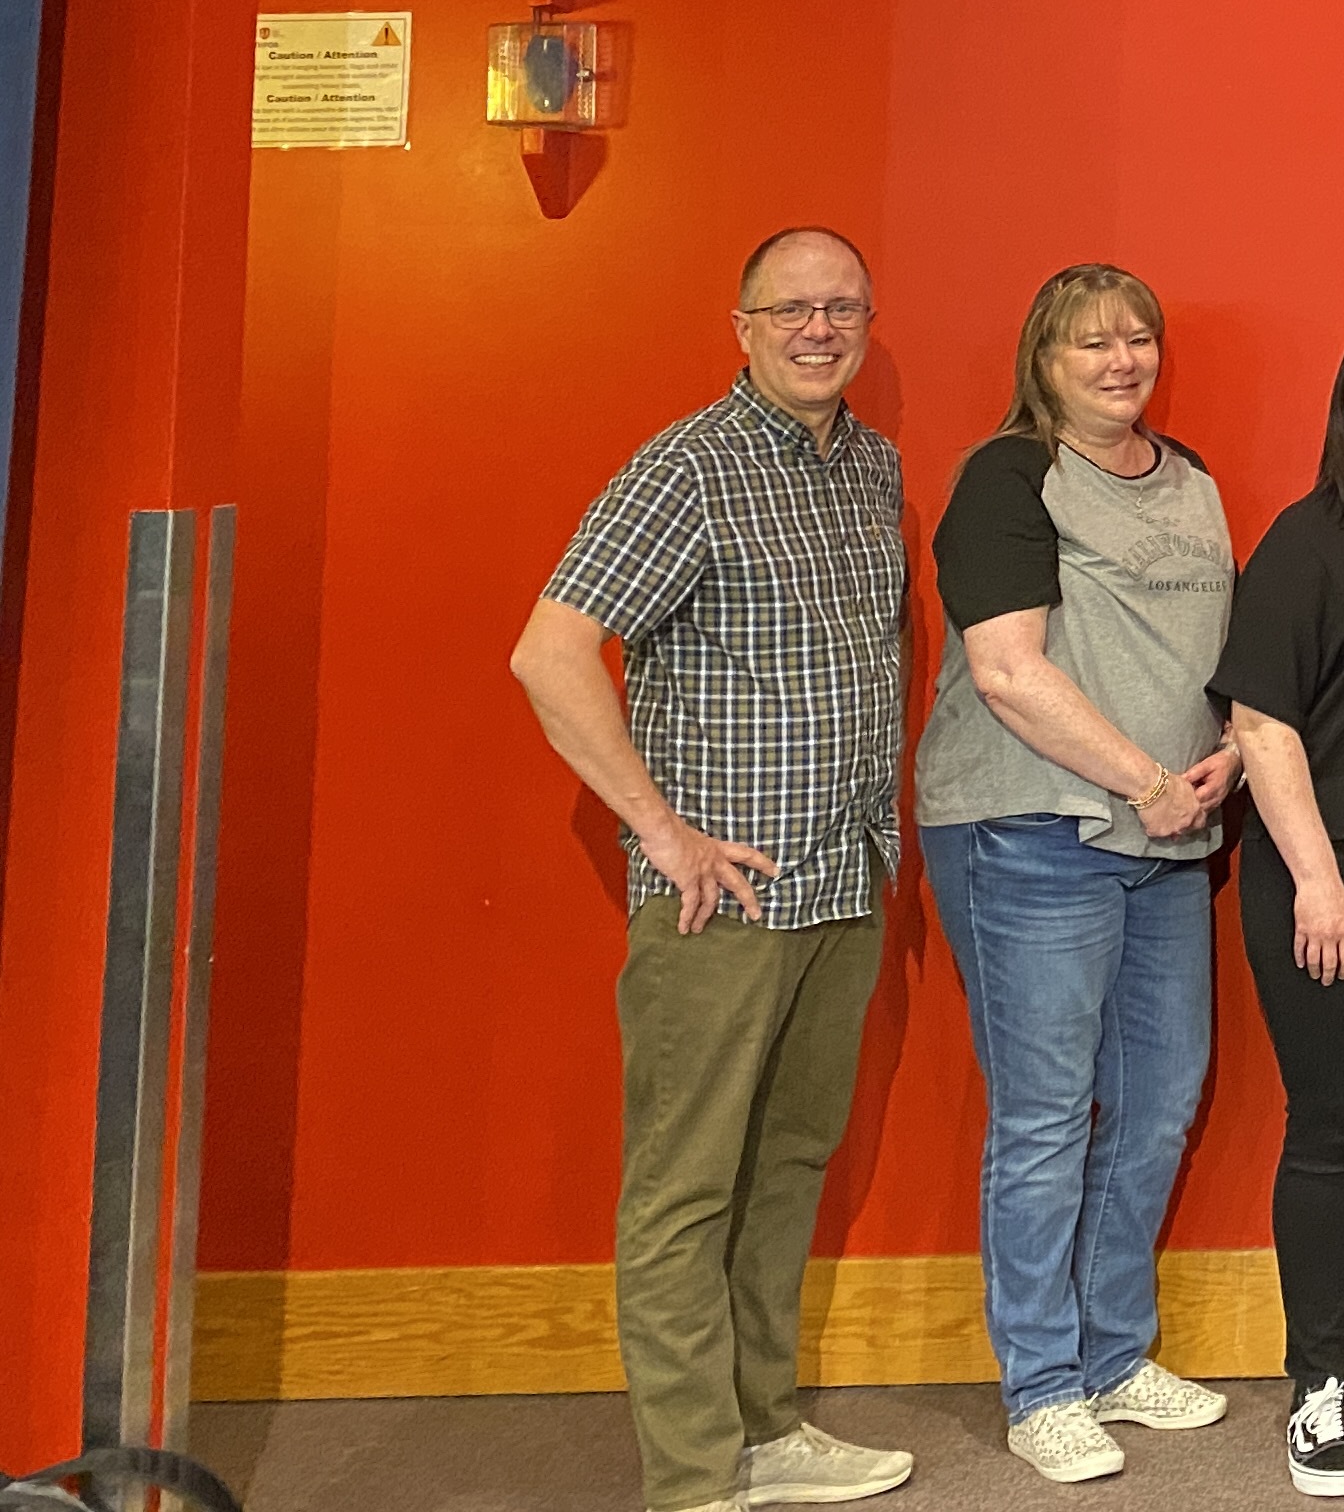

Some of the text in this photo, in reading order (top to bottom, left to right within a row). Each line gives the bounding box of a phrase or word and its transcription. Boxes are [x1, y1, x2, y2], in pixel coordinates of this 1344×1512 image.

[268, 51, 314, 60] Caution
[323, 50, 378, 59] Attention
[266, 94, 311, 103] Caution
[321, 93, 376, 102] Attention
[1147, 579, 1172, 592] LOS
